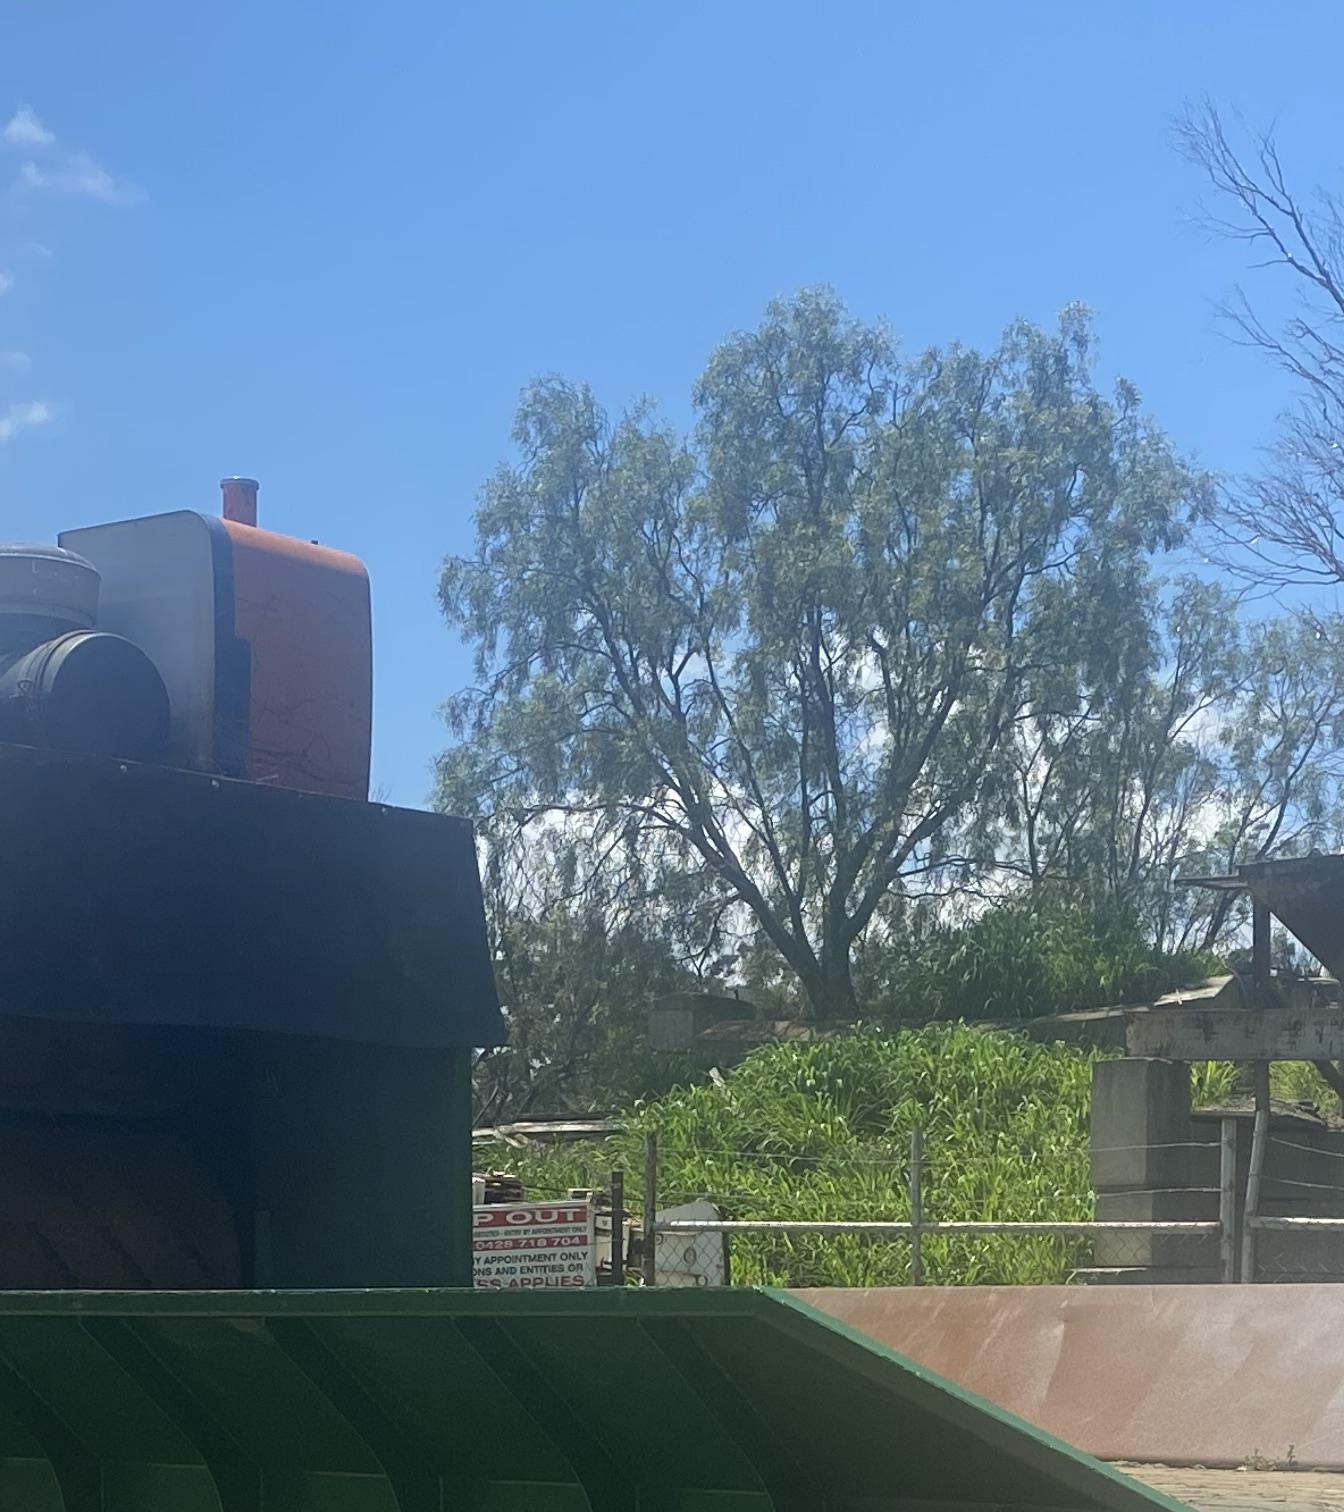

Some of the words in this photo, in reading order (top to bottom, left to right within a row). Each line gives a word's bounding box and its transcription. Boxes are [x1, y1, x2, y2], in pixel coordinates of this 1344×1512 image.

[505, 1208, 581, 1224] OUT
[475, 1240, 513, 1250] 0428
[518, 1238, 547, 1248] 718
[552, 1236, 581, 1246] 704
[484, 1252, 557, 1265] APPOINTMENT
[560, 1251, 588, 1261] ONLY
[495, 1266, 517, 1275] AND
[520, 1264, 565, 1275] ENTITIES
[568, 1263, 584, 1272] OR
[508, 1275, 585, 1288] APPLIES
